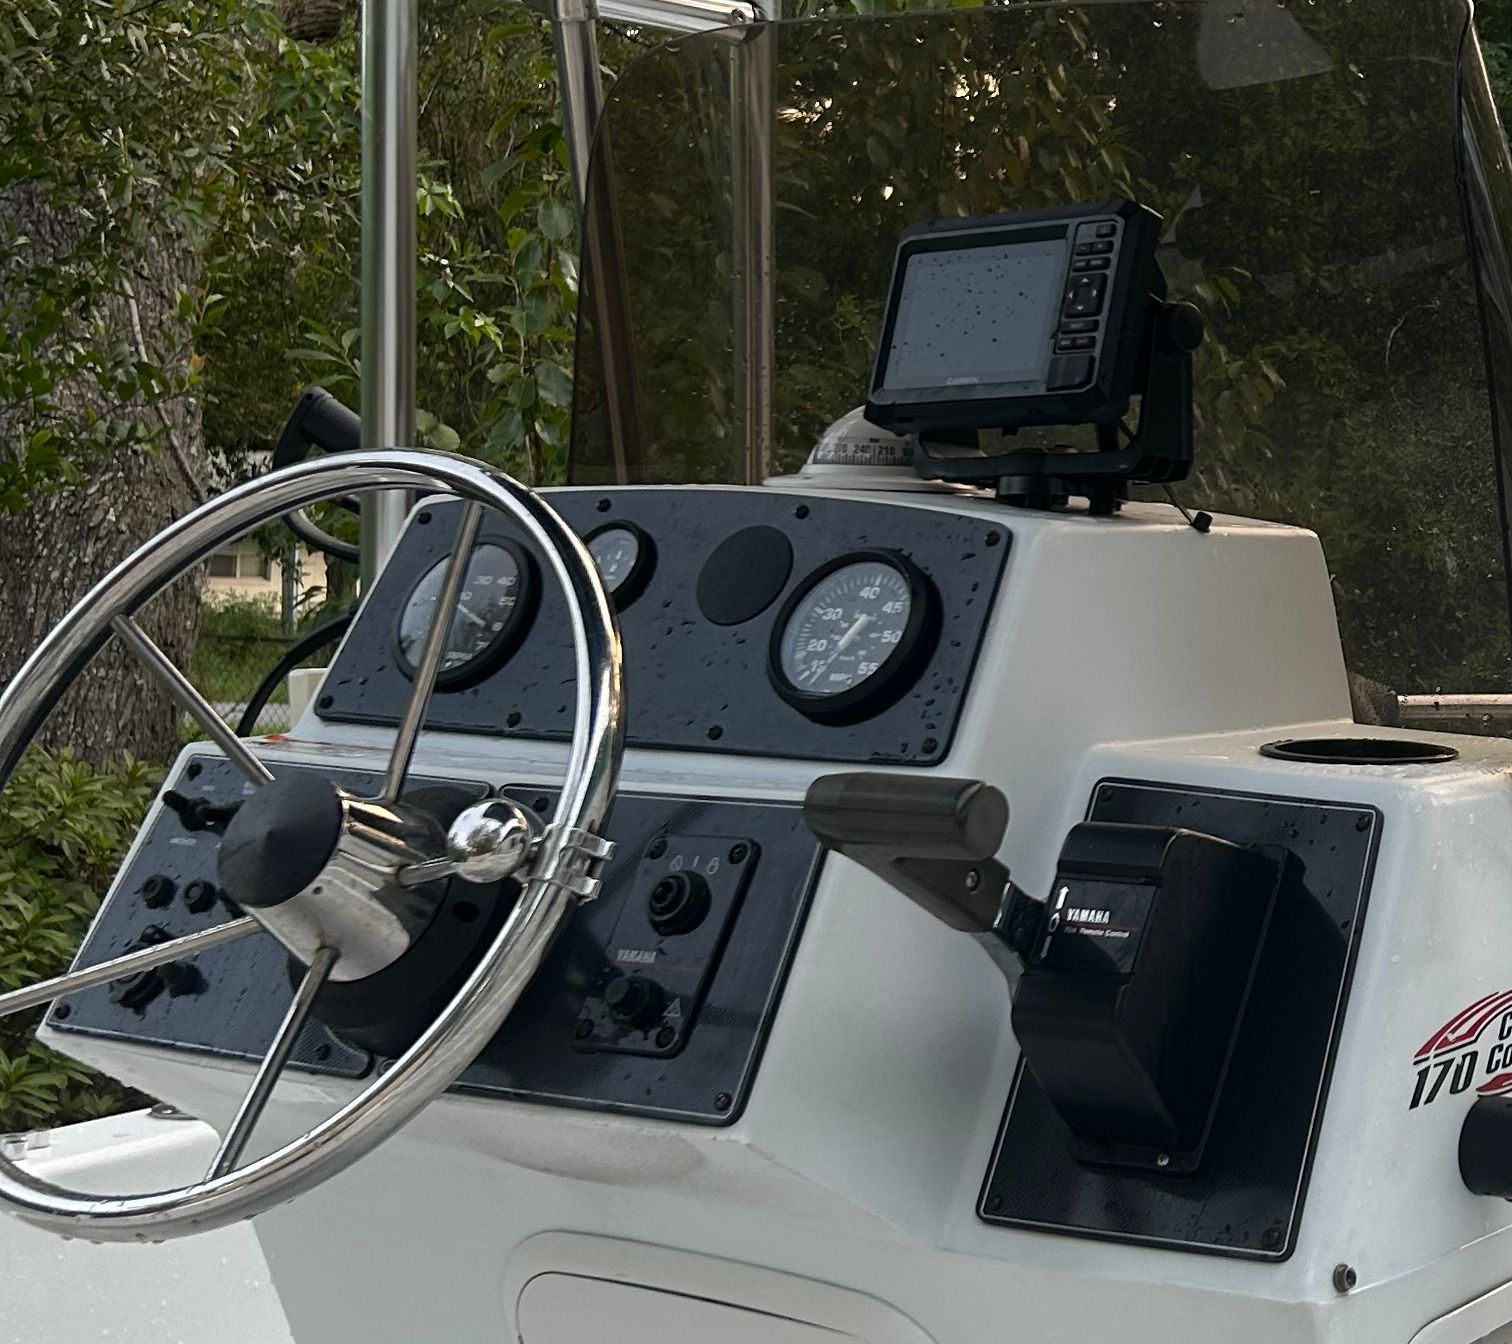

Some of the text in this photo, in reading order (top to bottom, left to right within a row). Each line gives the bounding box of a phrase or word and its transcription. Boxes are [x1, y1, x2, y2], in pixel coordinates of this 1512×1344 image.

[878, 445, 896, 457] 210
[859, 586, 880, 599] 40
[821, 607, 843, 620] 30
[881, 601, 904, 614] 45
[881, 629, 902, 643] 50
[807, 638, 828, 652] 20
[857, 661, 879, 676] 55
[1066, 908, 1111, 924] YAMAHA
[1408, 1050, 1479, 1111] 170
